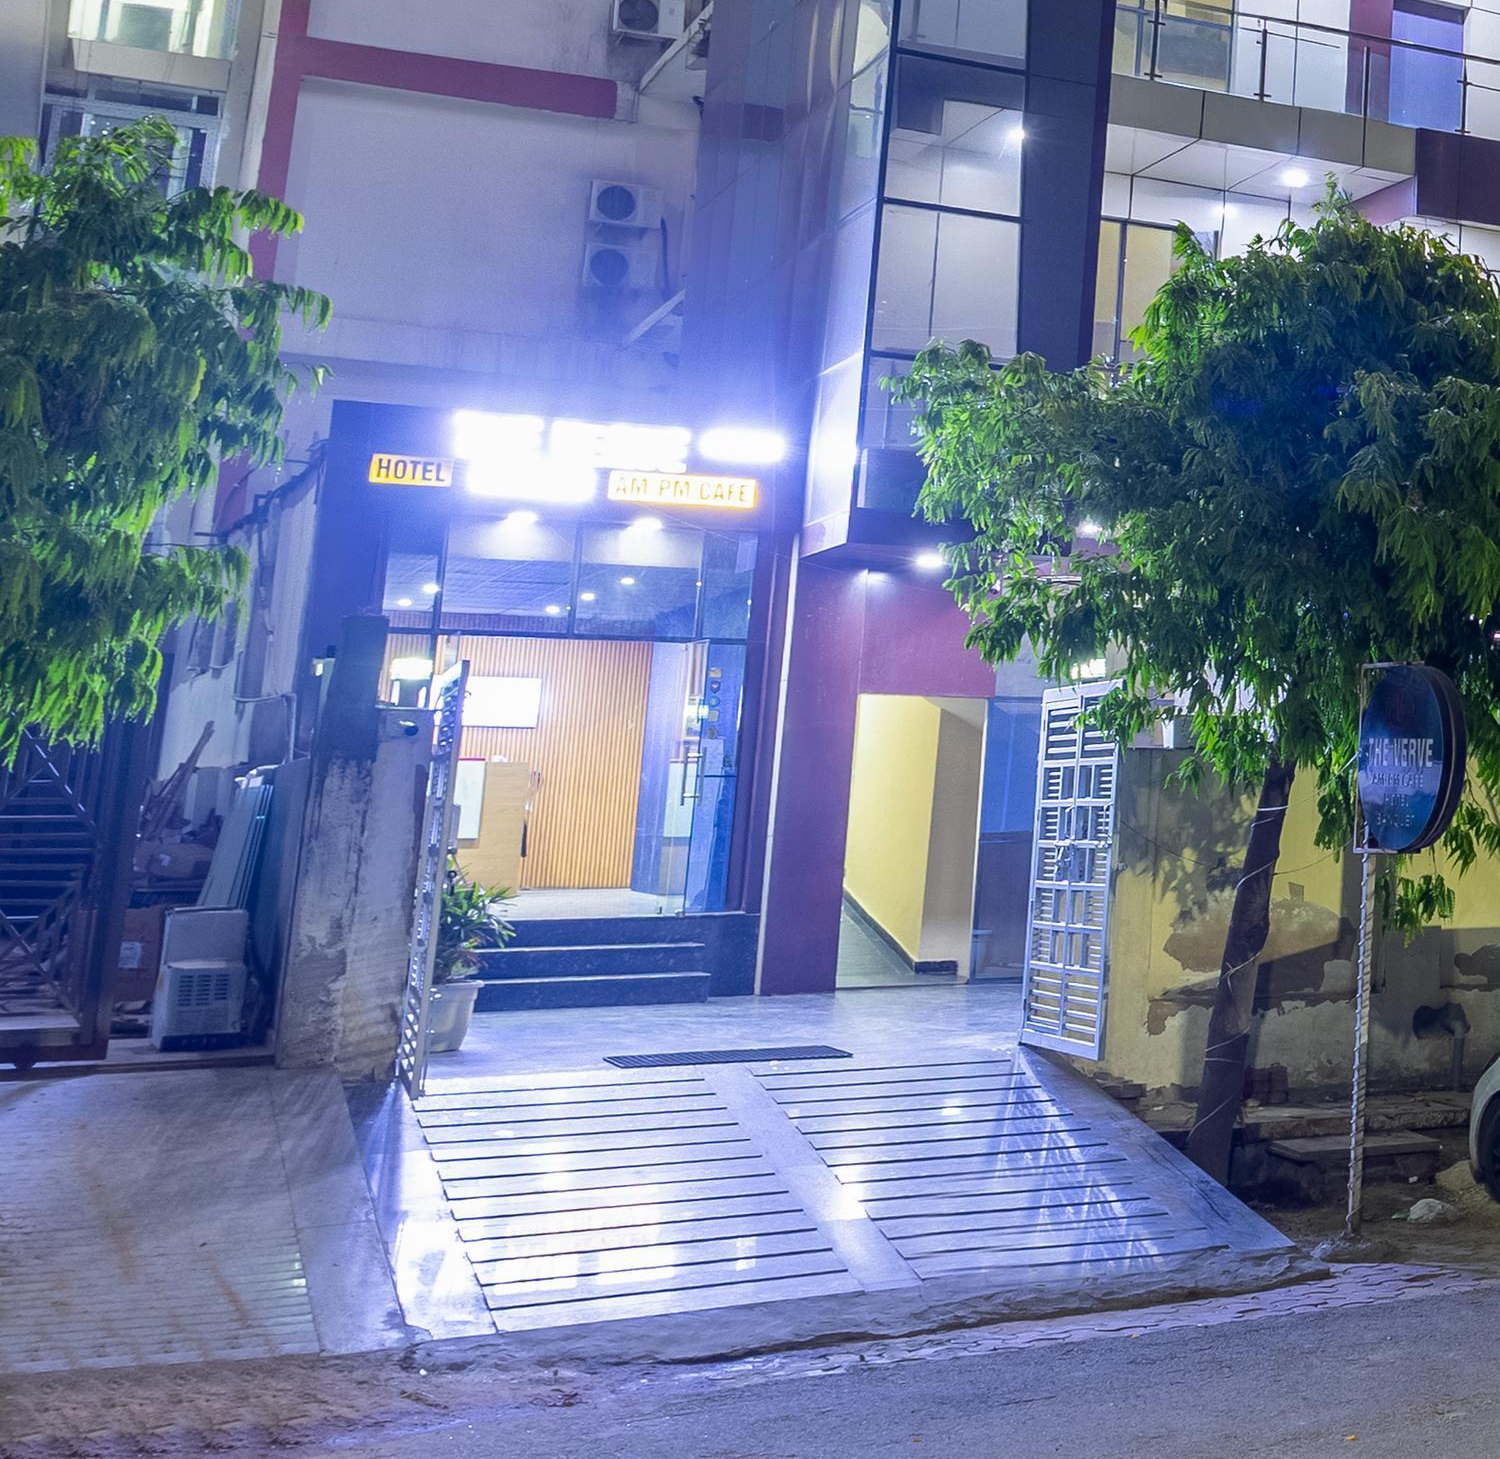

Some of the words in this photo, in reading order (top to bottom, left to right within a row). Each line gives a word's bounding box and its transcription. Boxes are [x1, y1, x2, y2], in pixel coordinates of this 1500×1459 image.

[376, 458, 445, 482] HOTEL
[616, 477, 648, 495] AM
[659, 479, 690, 499] PM
[699, 482, 749, 502] CAFE
[1369, 738, 1389, 767] THE
[1393, 738, 1434, 768] VERVE
